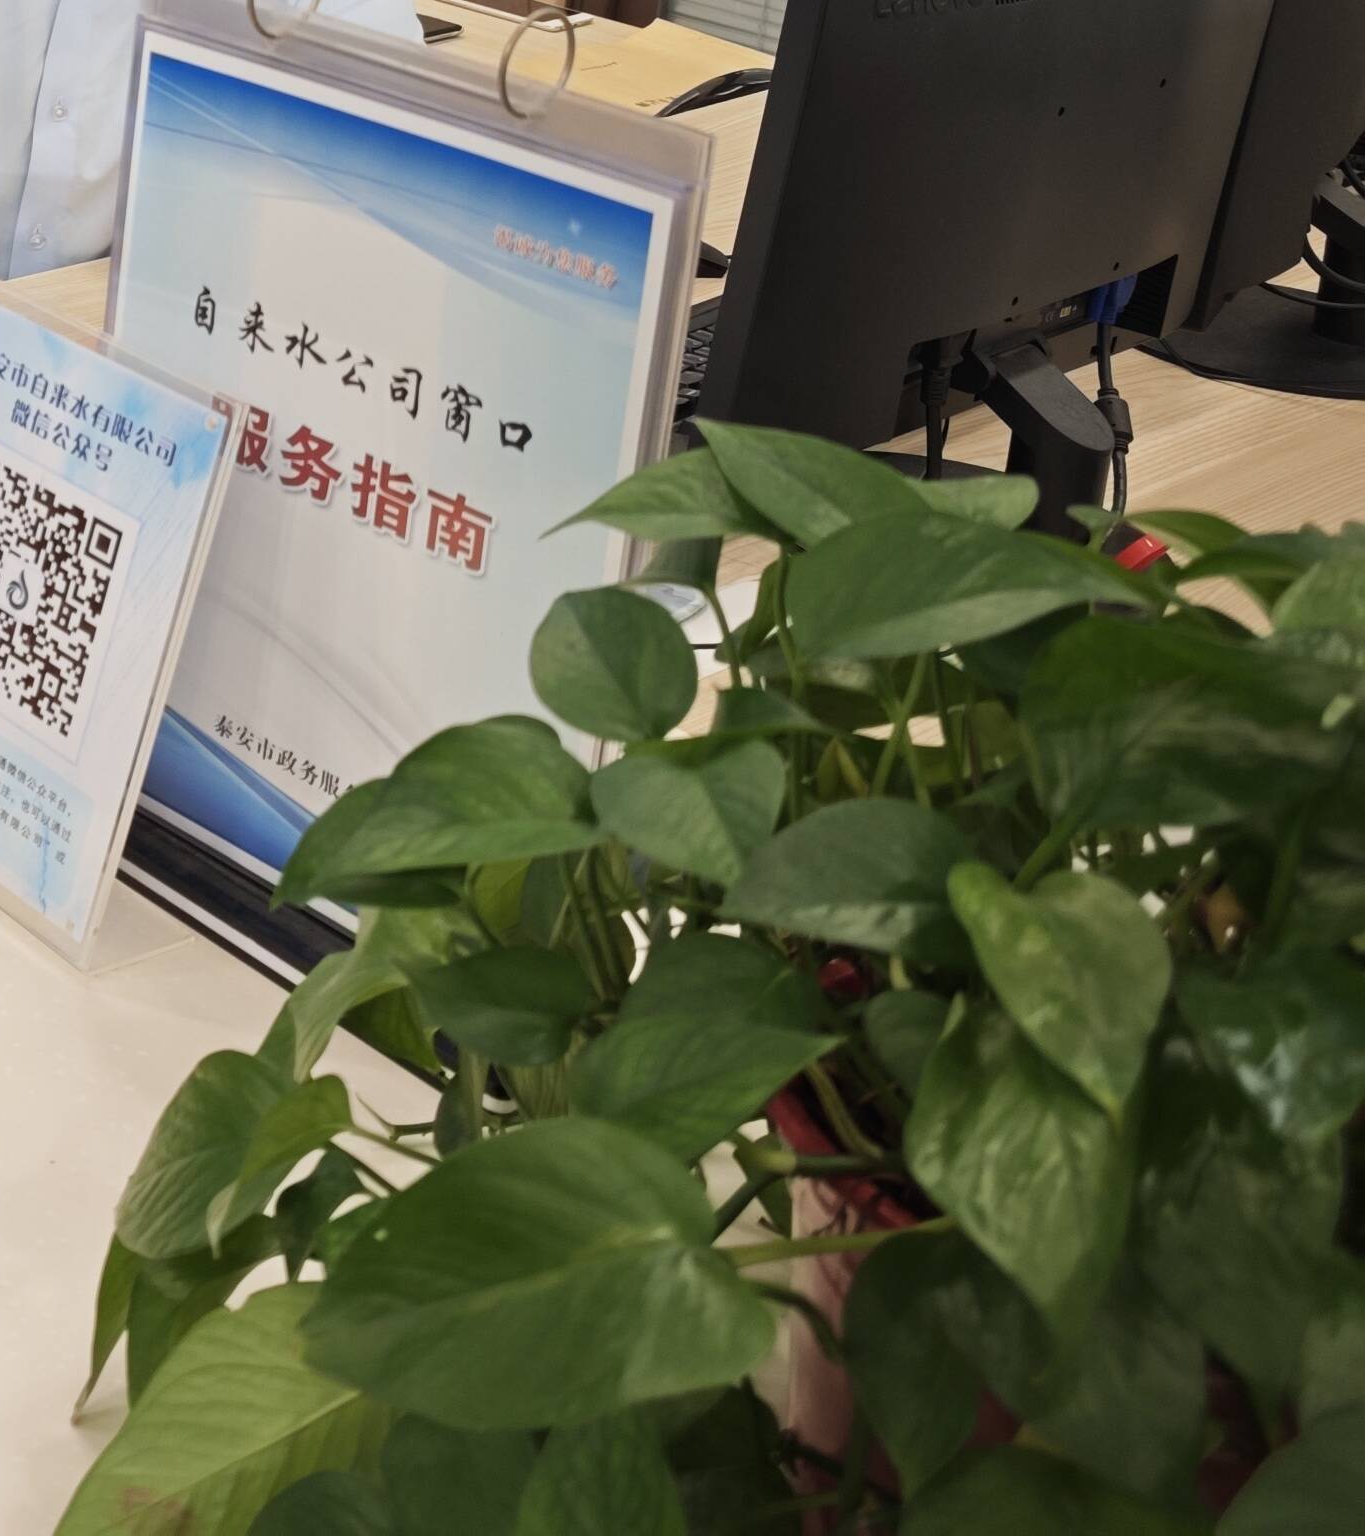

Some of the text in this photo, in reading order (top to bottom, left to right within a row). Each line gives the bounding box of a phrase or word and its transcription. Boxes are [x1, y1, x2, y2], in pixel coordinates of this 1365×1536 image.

[194, 285, 534, 453] 自来水公司窗口
[10, 399, 114, 472] 微信公众号
[215, 714, 354, 799] 泰安市政务服
